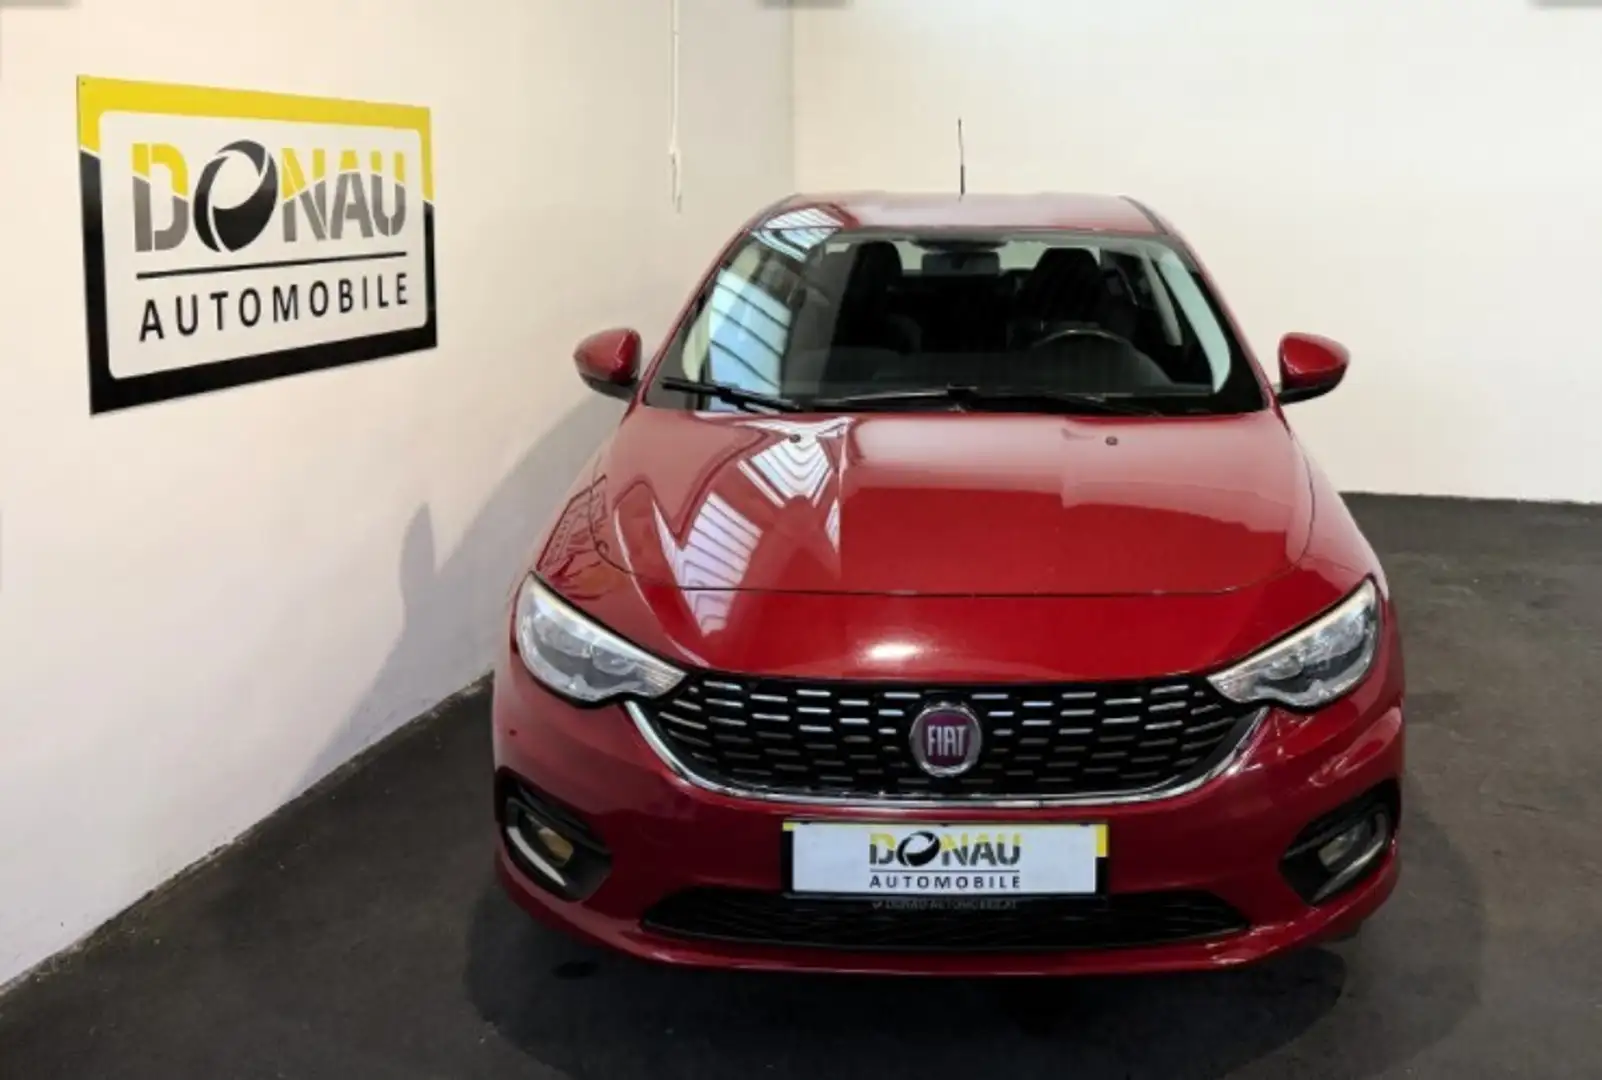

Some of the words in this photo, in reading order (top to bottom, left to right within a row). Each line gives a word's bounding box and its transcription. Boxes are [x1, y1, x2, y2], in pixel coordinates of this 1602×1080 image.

[132, 139, 407, 253] DONAU
[138, 272, 408, 342] AUTOMOBILE
[927, 725, 967, 757] FIAT
[869, 830, 1021, 867] DONAU
[869, 875, 1021, 889] AUTOMOBILE
